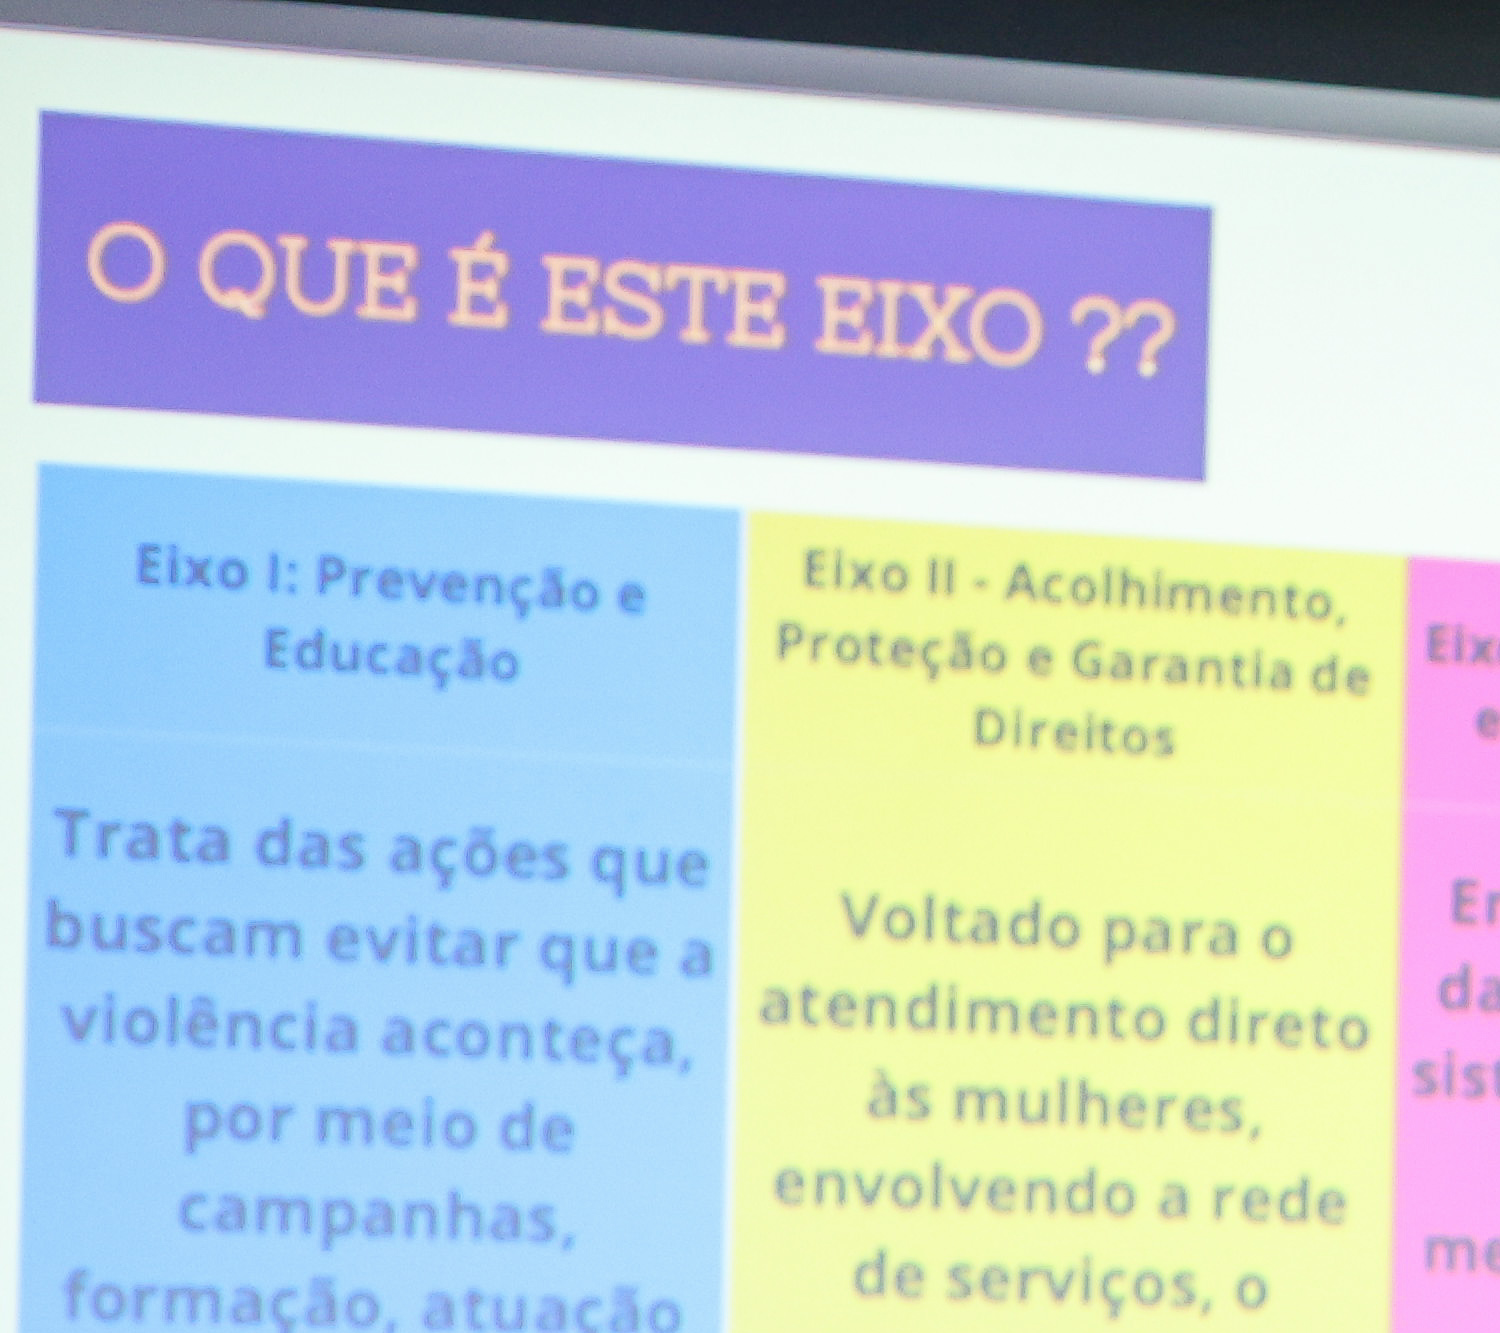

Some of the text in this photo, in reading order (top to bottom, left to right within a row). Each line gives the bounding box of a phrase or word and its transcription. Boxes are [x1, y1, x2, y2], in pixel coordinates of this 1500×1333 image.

[87, 220, 1177, 378] O QUE É ESTE EIXO ??
[137, 543, 646, 619] Eixo I: Prevenção e
[803, 547, 910, 593] Eixo
[928, 556, 956, 596] II
[1004, 561, 1345, 628] Acolhimento,
[264, 627, 520, 691] Educação
[776, 620, 1371, 698] Proteção e Garantia de
[973, 706, 1176, 758] Direitos
[54, 807, 710, 898] Trata das ações que
[46, 898, 714, 986] buscam evitar que a
[840, 891, 1294, 964] Voltado para o
[61, 993, 692, 1080] violência aconteça,
[759, 983, 1370, 1052] atendimento direto
[185, 1098, 576, 1155] por meio de
[866, 1069, 1261, 1141] às mulheres,
[179, 1191, 574, 1250] campanhas,
[773, 1161, 1347, 1226] envolvendo a rede
[853, 1247, 1269, 1319] de serviços, o
